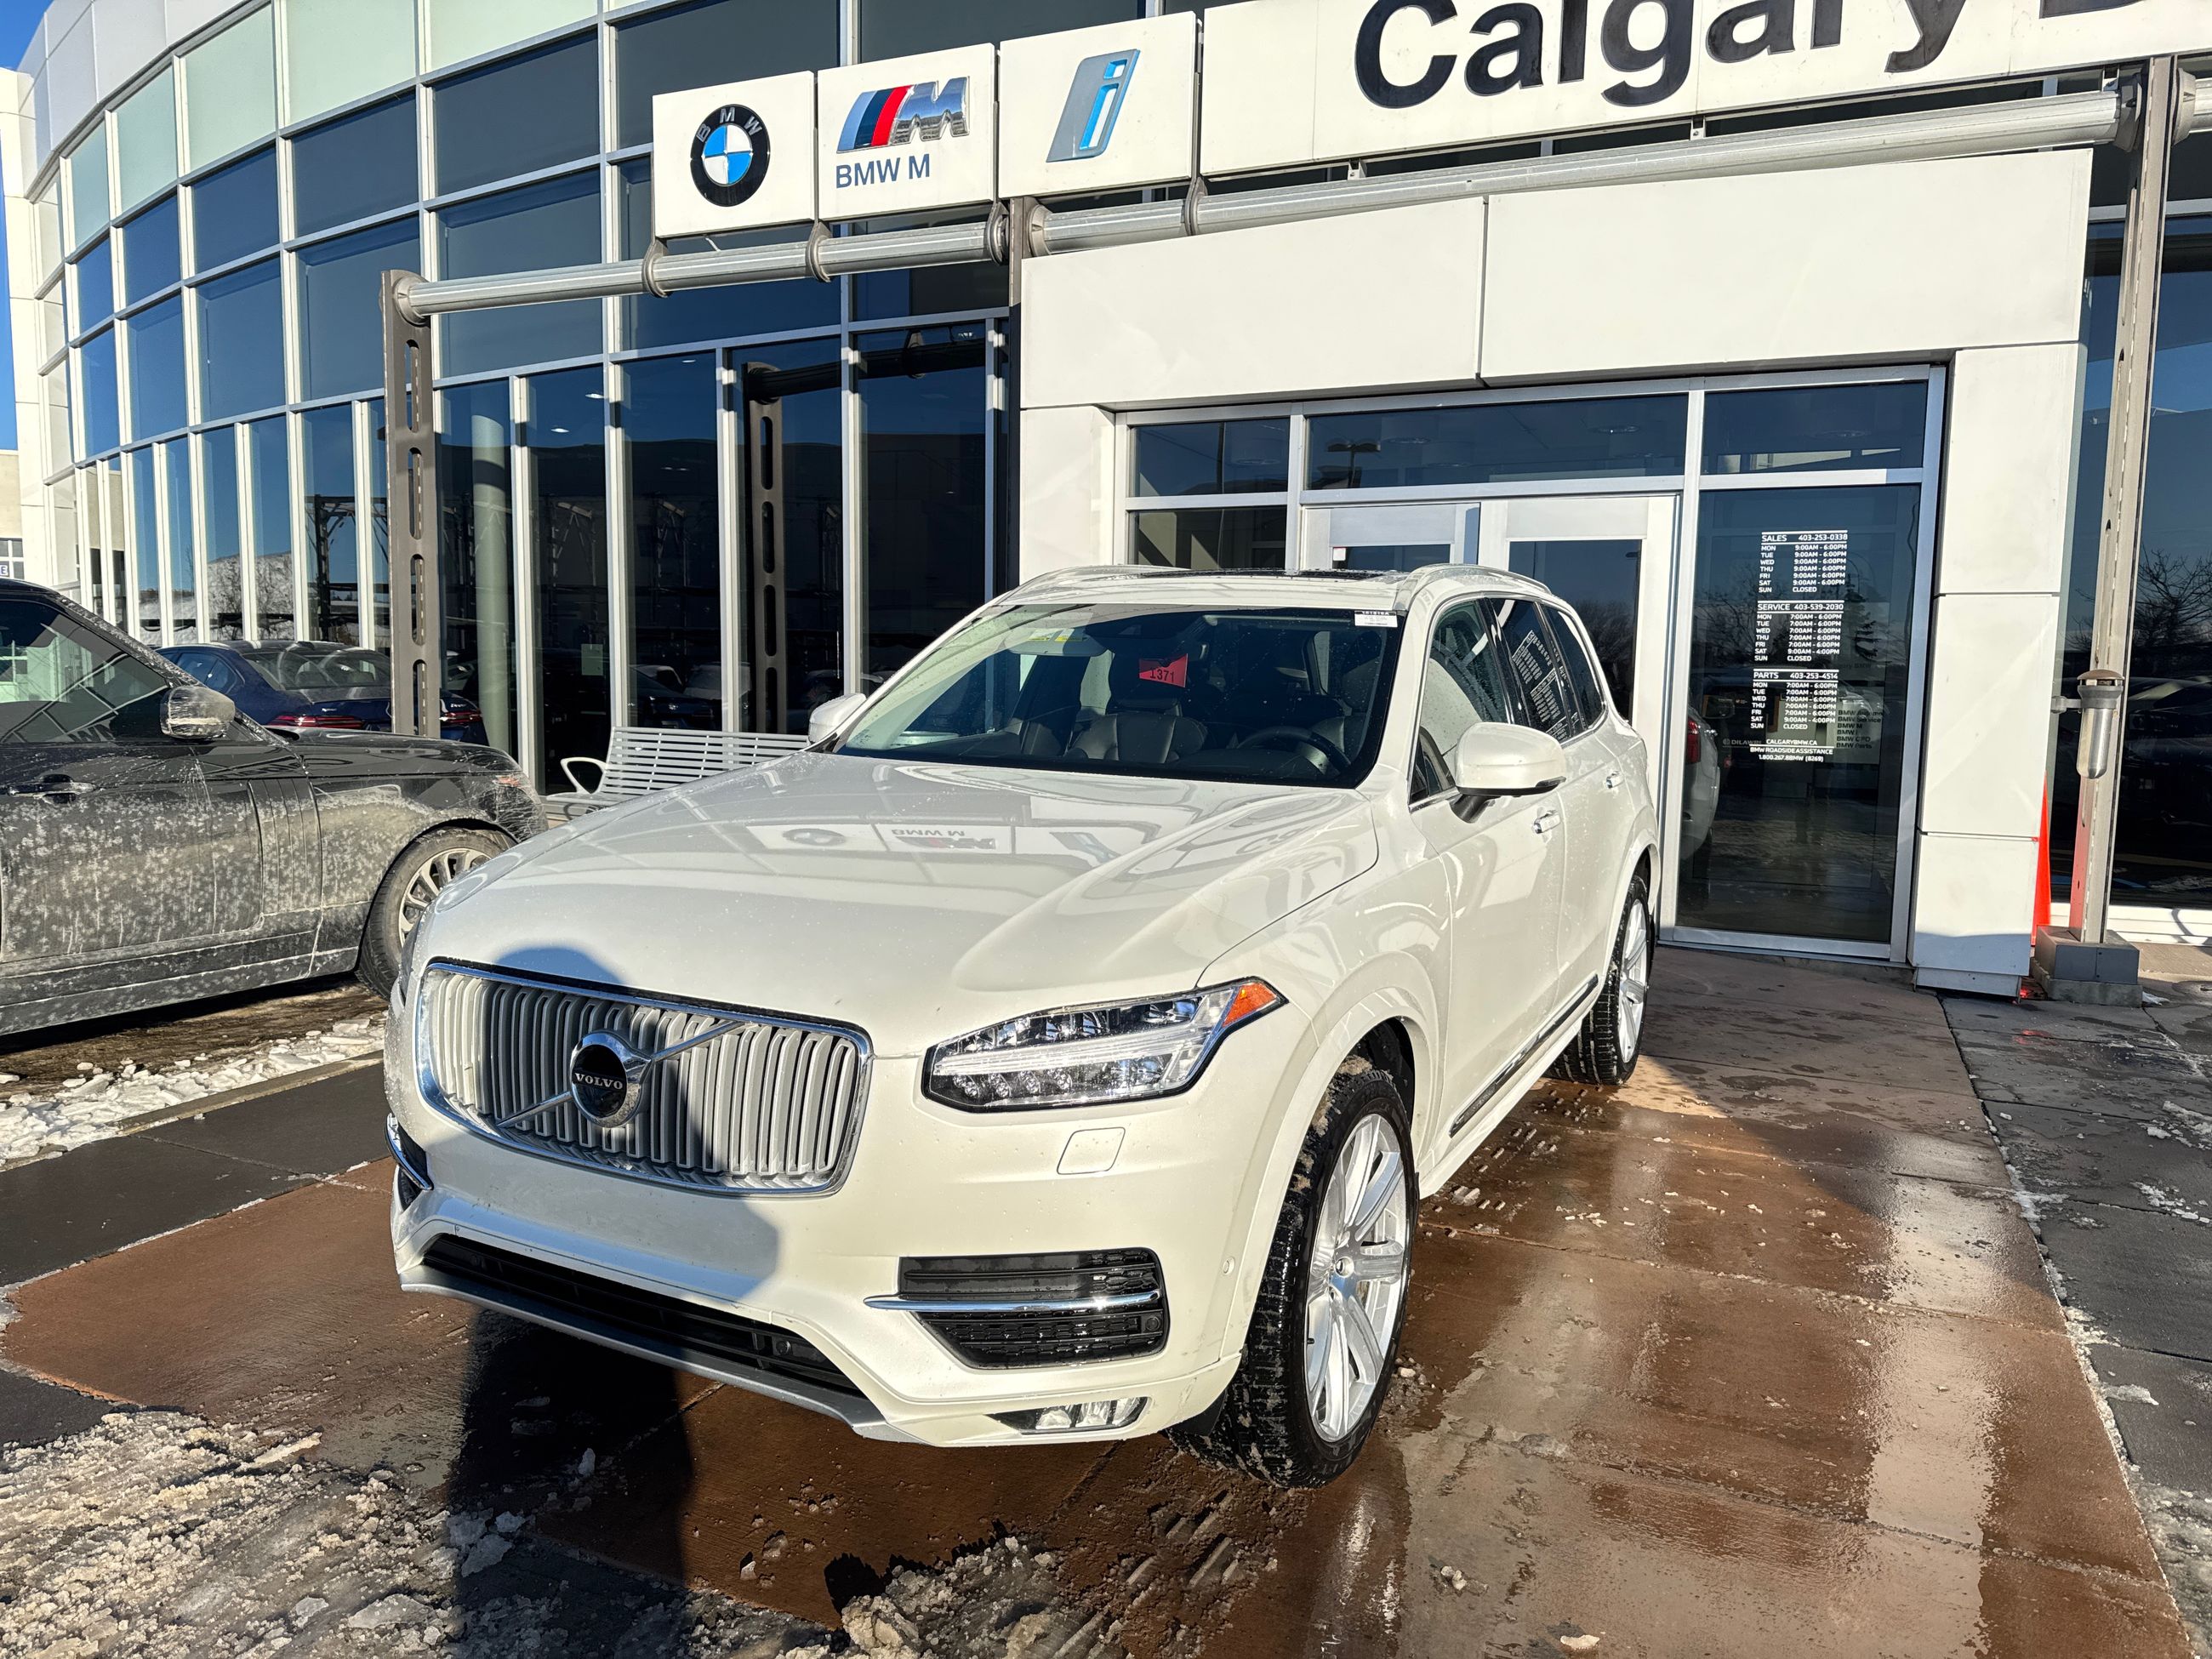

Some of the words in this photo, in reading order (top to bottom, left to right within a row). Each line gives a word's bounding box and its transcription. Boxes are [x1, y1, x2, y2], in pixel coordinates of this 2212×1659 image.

[696, 107, 763, 143] BMW
[836, 158, 901, 188] BMW
[909, 155, 930, 179] M
[574, 1073, 623, 1090] VOLVO
